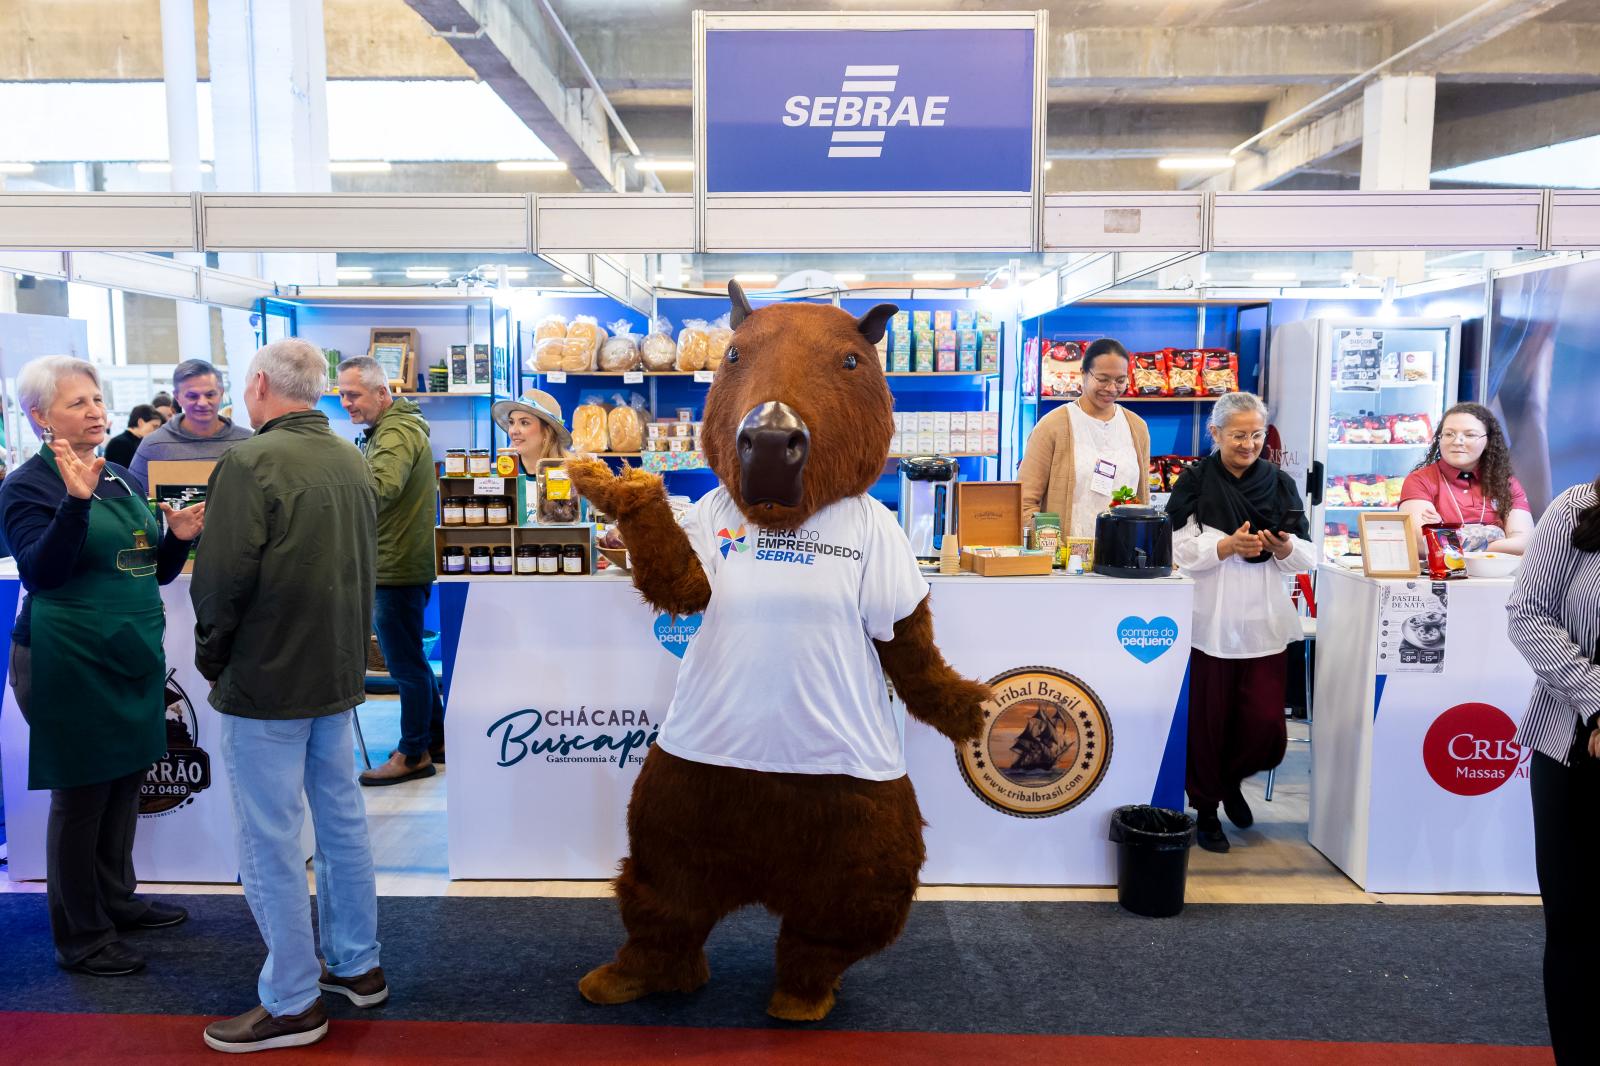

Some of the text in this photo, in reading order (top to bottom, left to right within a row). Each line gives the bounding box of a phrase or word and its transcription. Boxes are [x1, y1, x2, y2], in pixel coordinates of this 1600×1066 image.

[782, 95, 950, 127] SEBRAE
[757, 527, 820, 541] FEIRA DO
[755, 549, 816, 565] SEBRAE
[658, 625, 696, 636] compre
[1121, 627, 1175, 638] compre do
[658, 634, 694, 645] pequ
[1121, 637, 1174, 648] pequeno
[992, 681, 1081, 710] Tribal Brasil
[544, 705, 650, 727] CHÁCARA
[1447, 733, 1533, 765] CRIS
[546, 754, 607, 763] Gastronomia
[609, 754, 617, 763] &
[1456, 766, 1530, 779] Massas Al
[141, 785, 187, 794] 02 0489
[982, 772, 1084, 802] www.tribalbrasil.com
